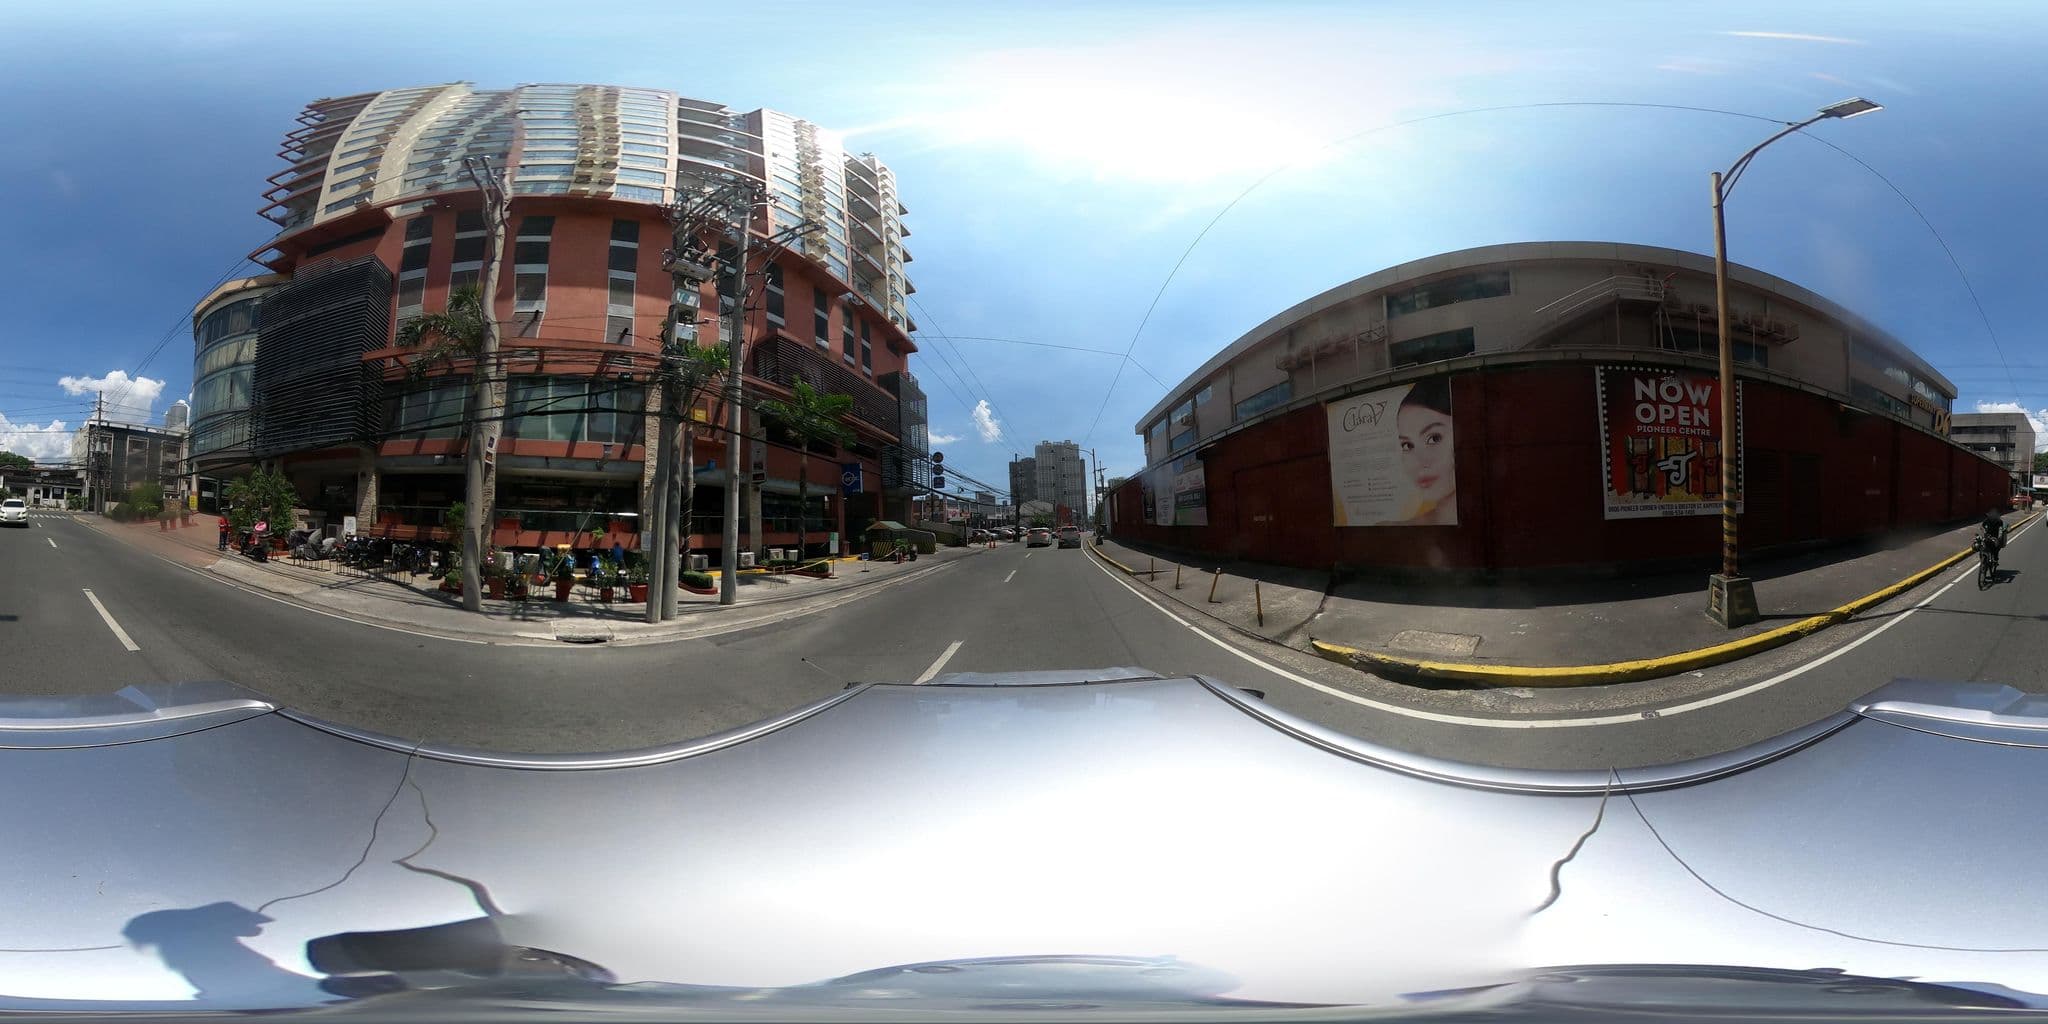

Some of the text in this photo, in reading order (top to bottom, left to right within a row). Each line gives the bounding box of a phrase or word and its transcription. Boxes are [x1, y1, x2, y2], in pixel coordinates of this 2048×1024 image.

[1634, 377, 1712, 406] NOW
[1635, 403, 1710, 427] OPEN
[1637, 425, 1711, 436] PIONEER CENTRE
